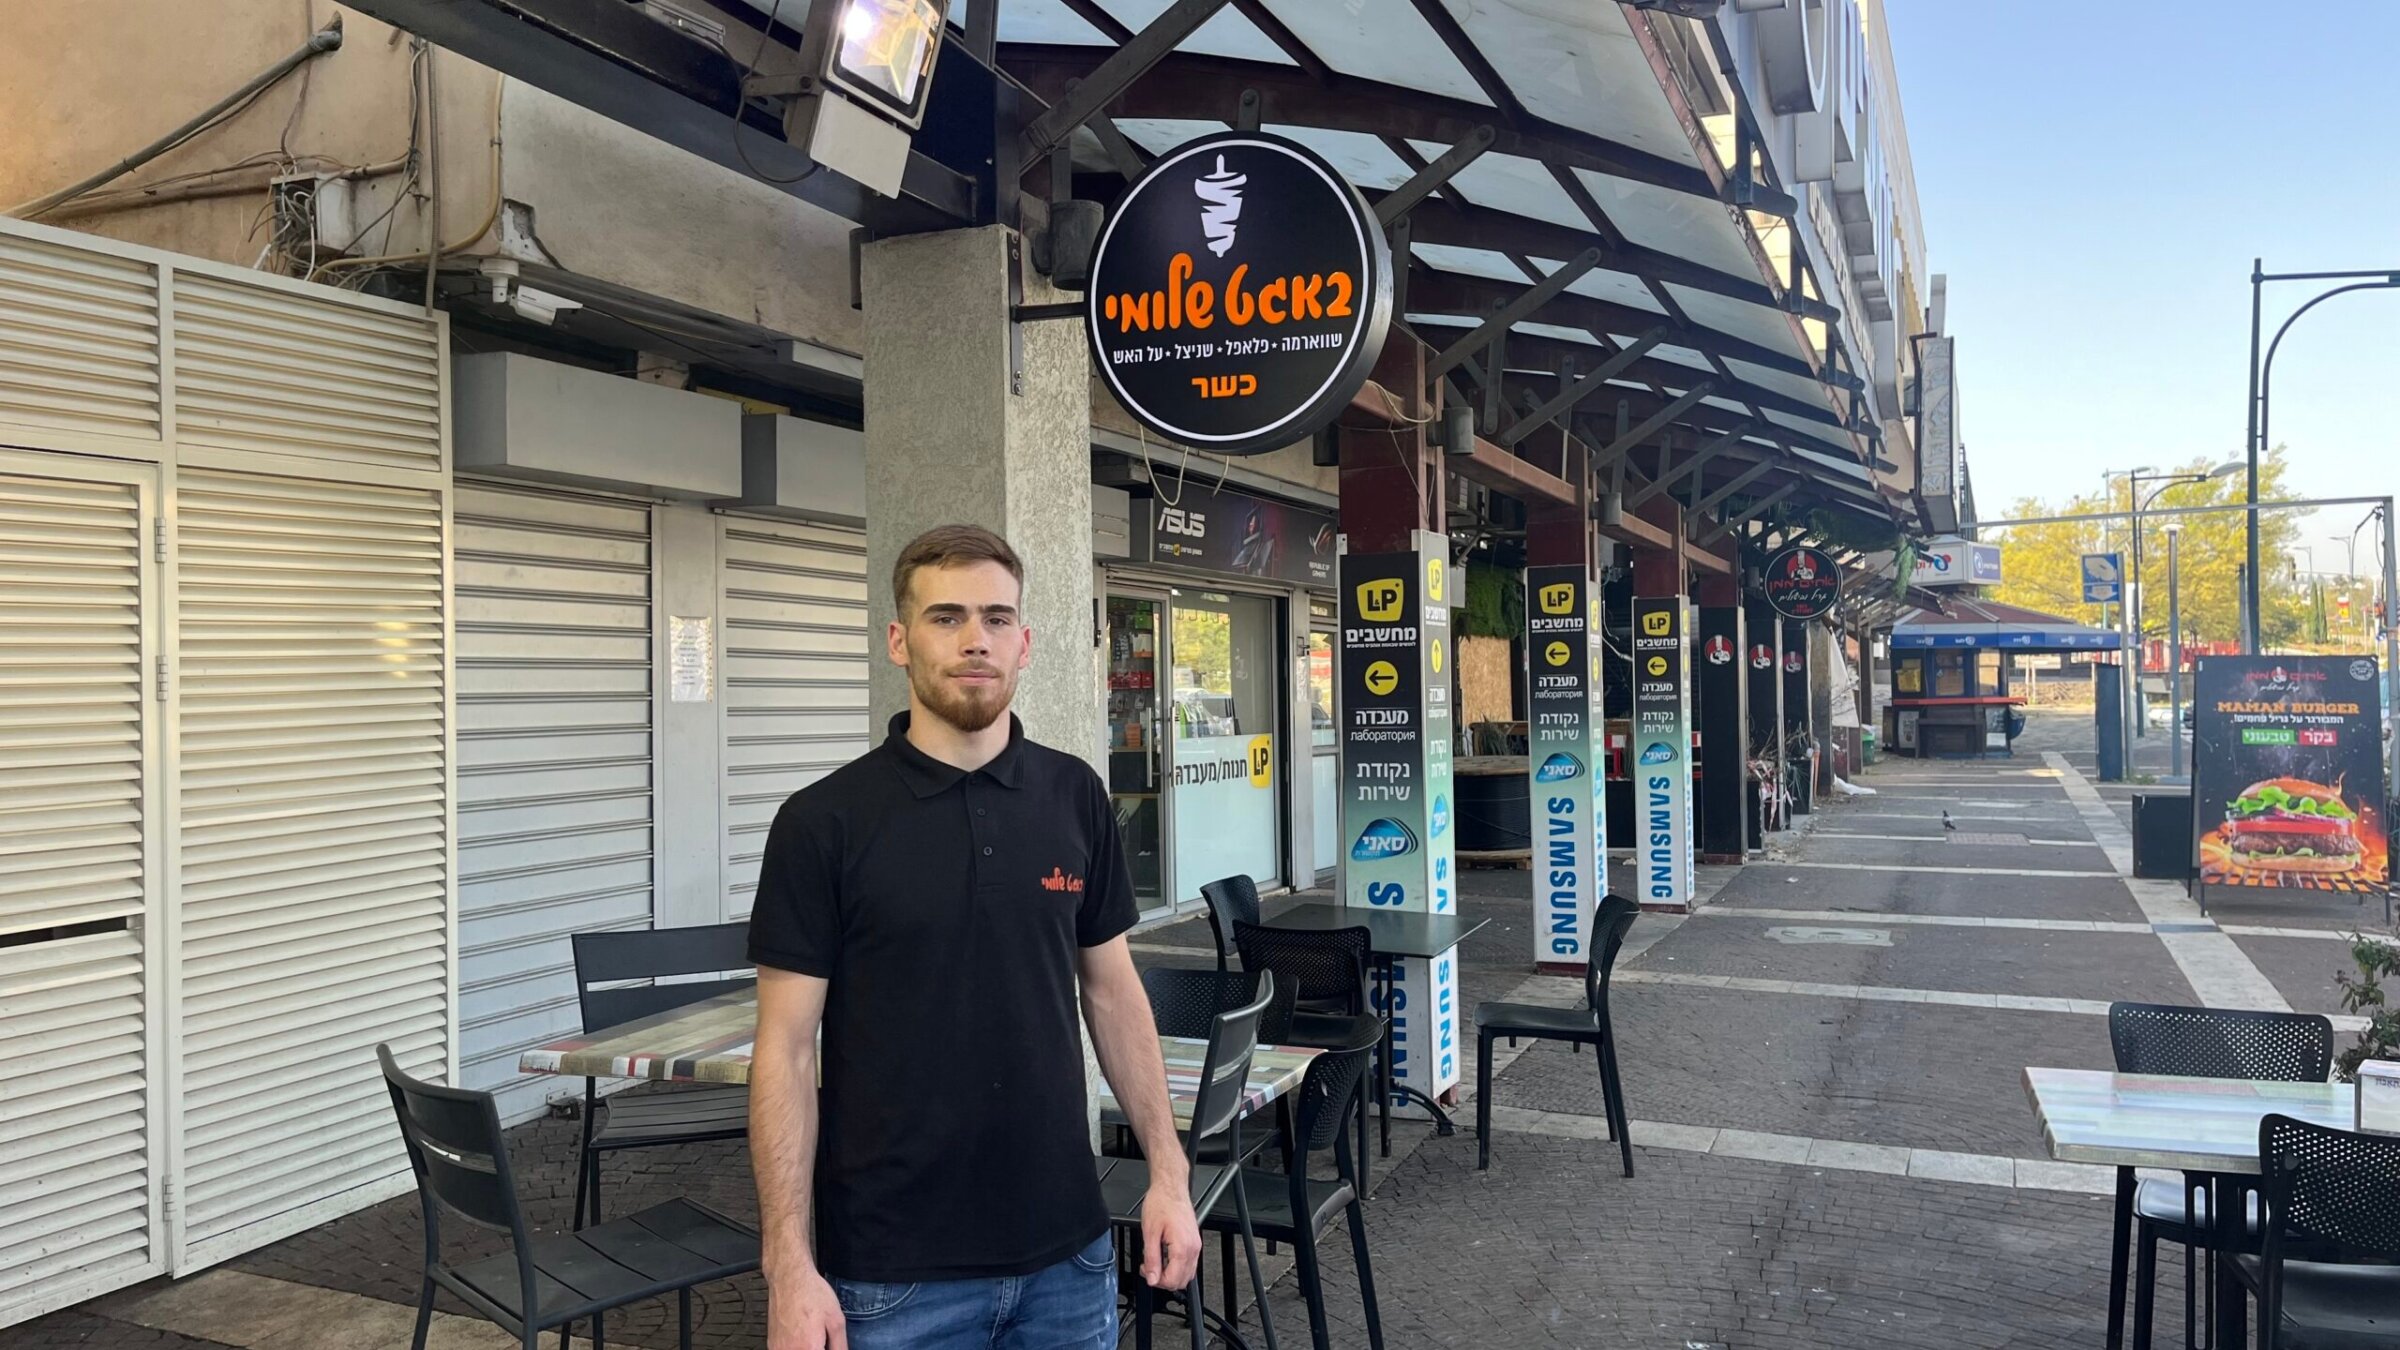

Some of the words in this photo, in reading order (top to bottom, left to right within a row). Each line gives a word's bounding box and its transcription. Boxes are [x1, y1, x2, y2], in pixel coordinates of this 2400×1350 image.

[1105, 253, 1214, 333] שלומי
[1225, 264, 1353, 326] באגט
[1225, 338, 1269, 356] פלאפל
[1282, 333, 1342, 352] שווארמה
[1113, 348, 1143, 364] האש
[1147, 346, 1163, 362] על
[1175, 342, 1213, 360] שניצל
[1191, 374, 1257, 399] כשר
[1158, 507, 1205, 538] ASUS
[1531, 617, 1584, 629] מחשבים
[1345, 627, 1417, 643] מחשבים
[1636, 638, 1678, 647] מחשבים
[1538, 676, 1578, 688] מעבדה
[1642, 683, 1673, 692] מעבדה
[1534, 689, 1583, 700] лаборатория
[2217, 702, 2285, 713] MAMAN
[2291, 703, 2360, 714] BURGER
[1355, 710, 1408, 725] מעבדה
[1539, 713, 1579, 728] נקודת
[1642, 711, 1674, 724] נקודת
[2269, 713, 2289, 724] גריל
[2290, 714, 2303, 724] על
[1350, 729, 1415, 743] лаборатория
[1540, 729, 1579, 741] שירות
[1643, 724, 1674, 734] שירות
[2244, 732, 2290, 742] טבעוני
[2304, 731, 2333, 745] בקר
[1645, 750, 1671, 760] סאני
[1356, 762, 1411, 783] נקודת
[1543, 765, 1576, 776] סאני
[1358, 785, 1411, 801] שירות
[1362, 835, 1406, 852] סאני
[1649, 776, 1673, 898] SAMSUNG
[1547, 797, 1579, 955] SAMSUNG
[1436, 857, 1452, 1079] SASUNG
